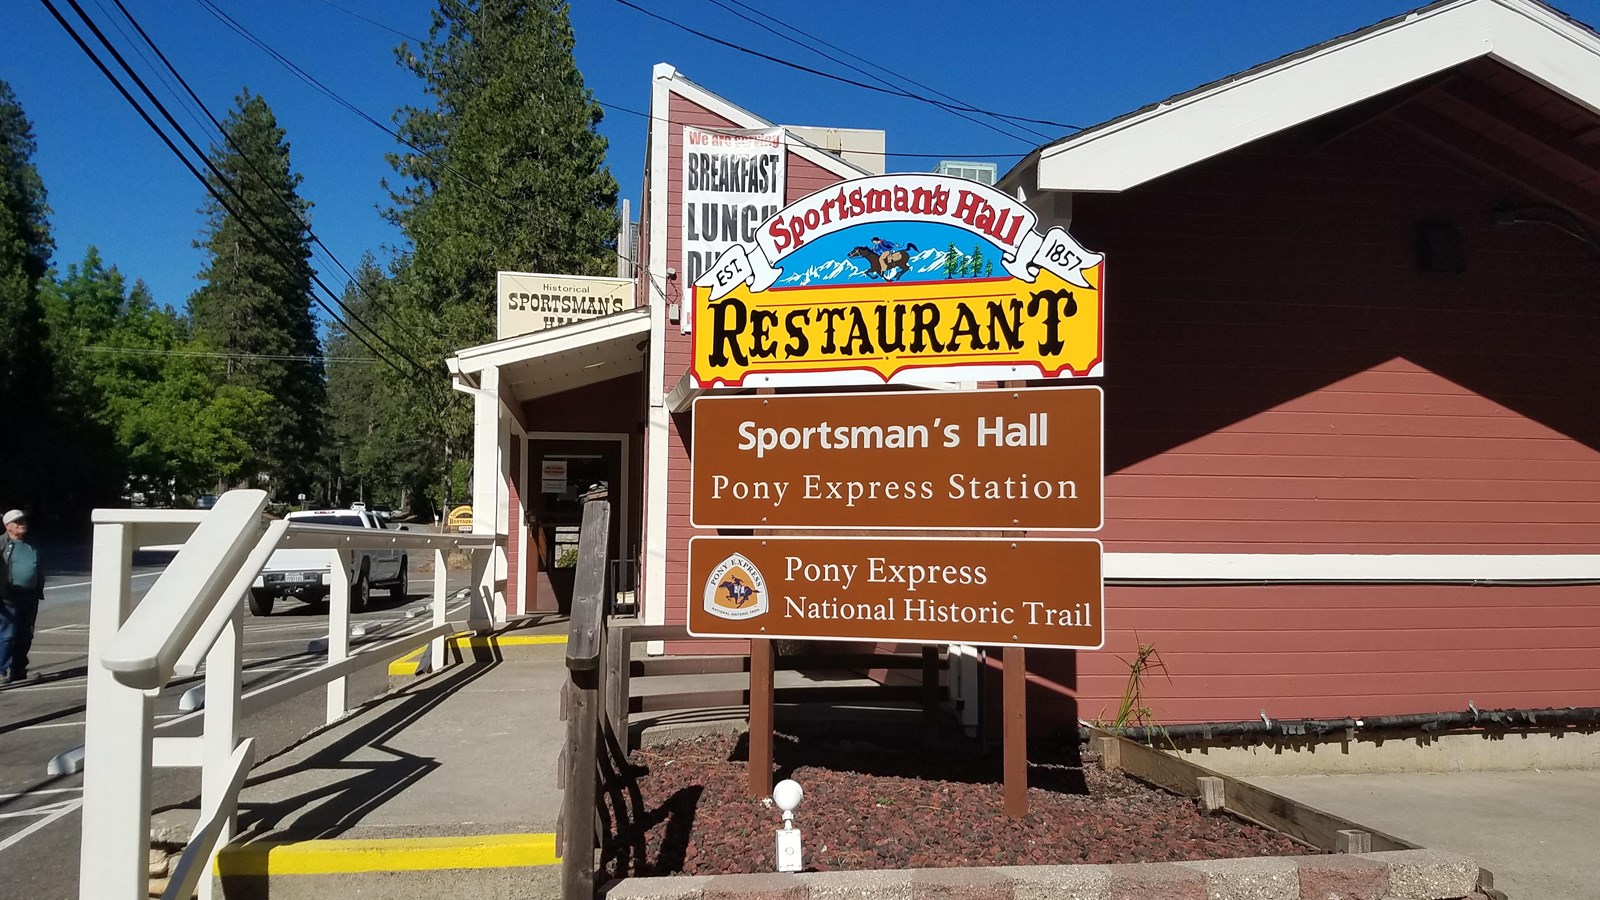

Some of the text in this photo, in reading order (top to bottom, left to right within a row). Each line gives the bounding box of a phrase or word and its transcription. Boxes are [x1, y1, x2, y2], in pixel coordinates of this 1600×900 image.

[689, 131, 709, 145] We
[712, 135, 732, 147] are
[688, 152, 779, 194] BREAKFAST
[768, 184, 1025, 254] Sportsman's Hall
[1045, 239, 1083, 270] 1857
[716, 258, 742, 286] EST.
[543, 283, 590, 293] Historical
[508, 292, 624, 316] SPORTSMAN'S
[707, 289, 1078, 368] RESTAURANT
[738, 413, 1049, 458] Sportsman's Hall
[711, 473, 1078, 507] Pony Express Station
[710, 558, 763, 588] PONY EXPRESS
[785, 557, 987, 591] Pony Express
[784, 596, 1092, 627] National Historic Trail
